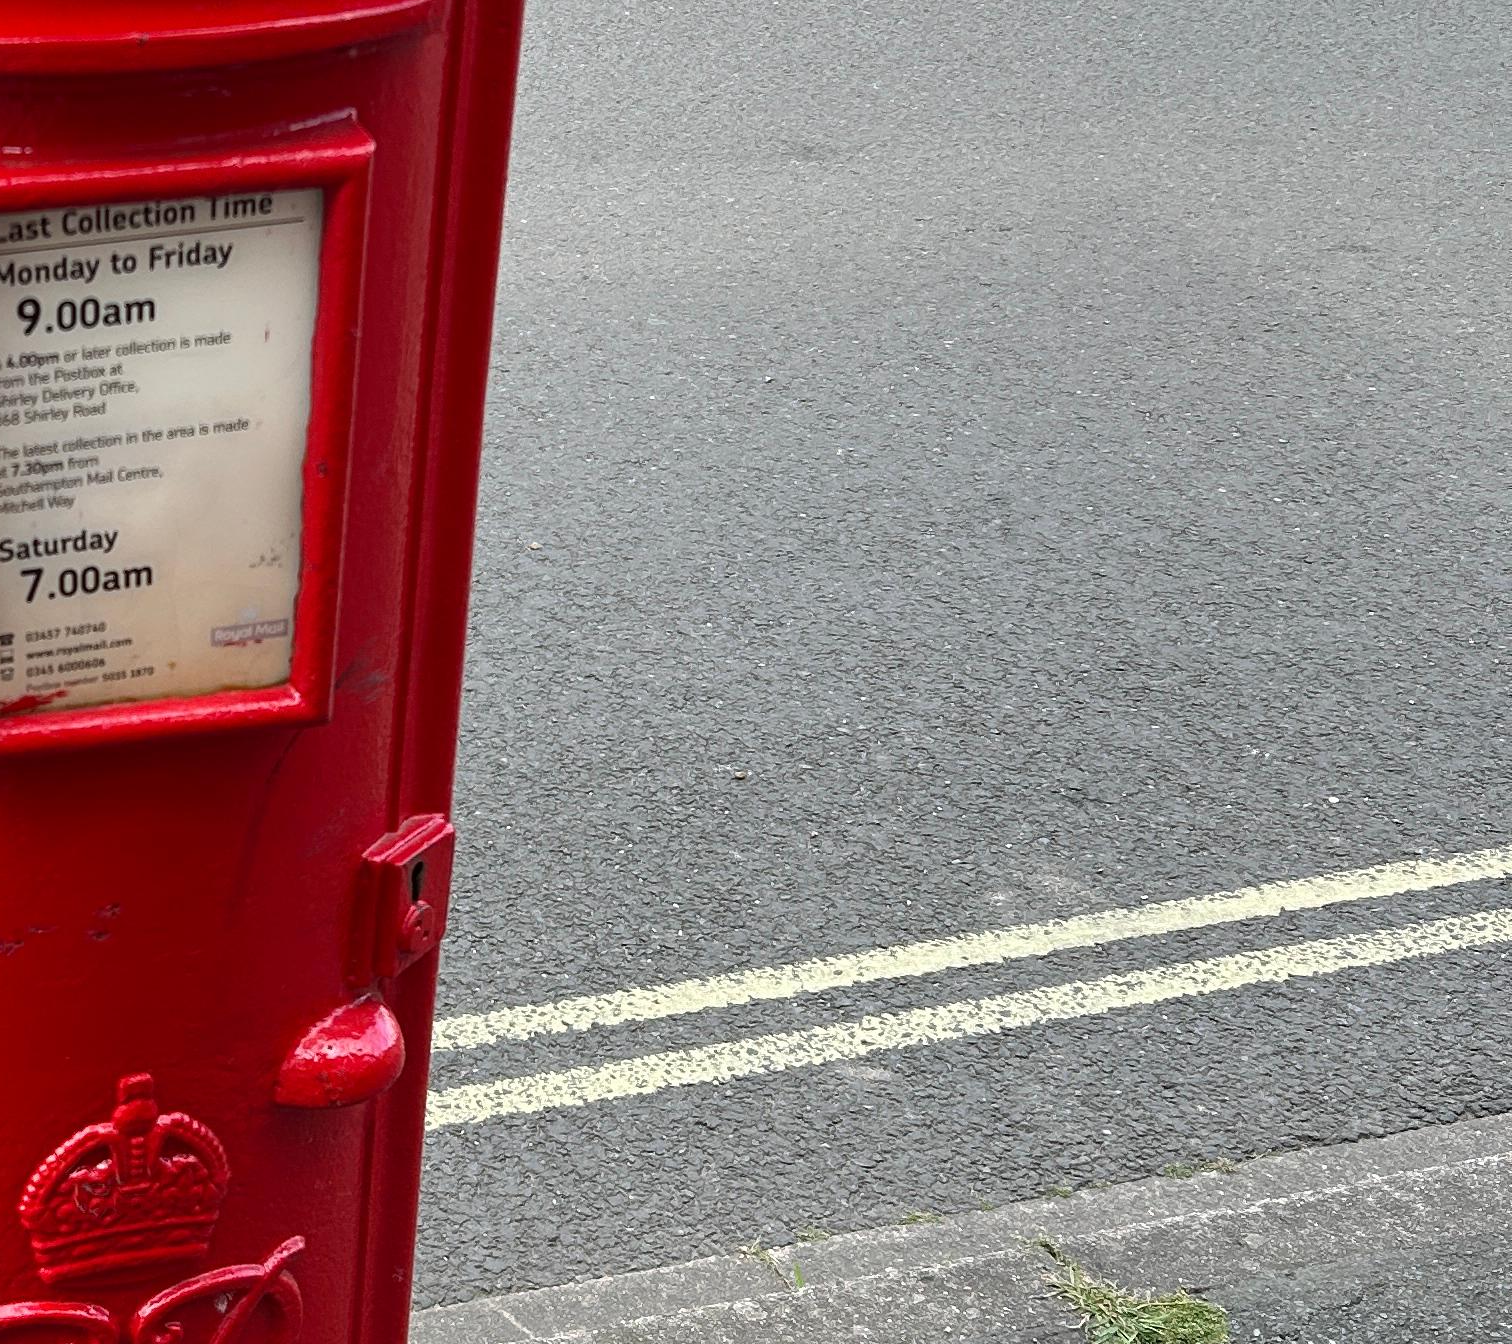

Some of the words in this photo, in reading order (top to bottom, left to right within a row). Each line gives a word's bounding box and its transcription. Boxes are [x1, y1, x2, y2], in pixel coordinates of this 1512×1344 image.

[61, 201, 195, 237] Collection
[208, 194, 273, 221] Time
[111, 253, 136, 274] to
[149, 240, 234, 271] Friday
[17, 297, 156, 336] 9.00am
[6, 354, 60, 370] 4.00pm
[63, 351, 78, 362] or
[81, 345, 112, 360] later
[115, 340, 176, 357] collection
[180, 337, 190, 349] is
[194, 332, 232, 346] made
[28, 371, 49, 385] the
[54, 366, 105, 382] Postbox
[109, 363, 123, 375] at
[42, 386, 94, 403] Delivery
[99, 380, 140, 396] Office,
[23, 408, 68, 424] Shirley
[72, 402, 106, 417] Road
[22, 442, 59, 457] latest
[62, 435, 122, 453] collection
[125, 432, 139, 444] in
[141, 428, 163, 443] the
[166, 426, 194, 440] area
[198, 424, 209, 436] is
[212, 419, 250, 434] made
[11, 461, 63, 478] 7.30pm
[67, 456, 100, 470] from
[86, 471, 114, 487] Mail
[117, 465, 164, 482] Centre,
[48, 495, 76, 509] Way
[20, 564, 154, 605] 7.00am
[214, 626, 252, 641] Royal
[255, 623, 286, 634] Mail
